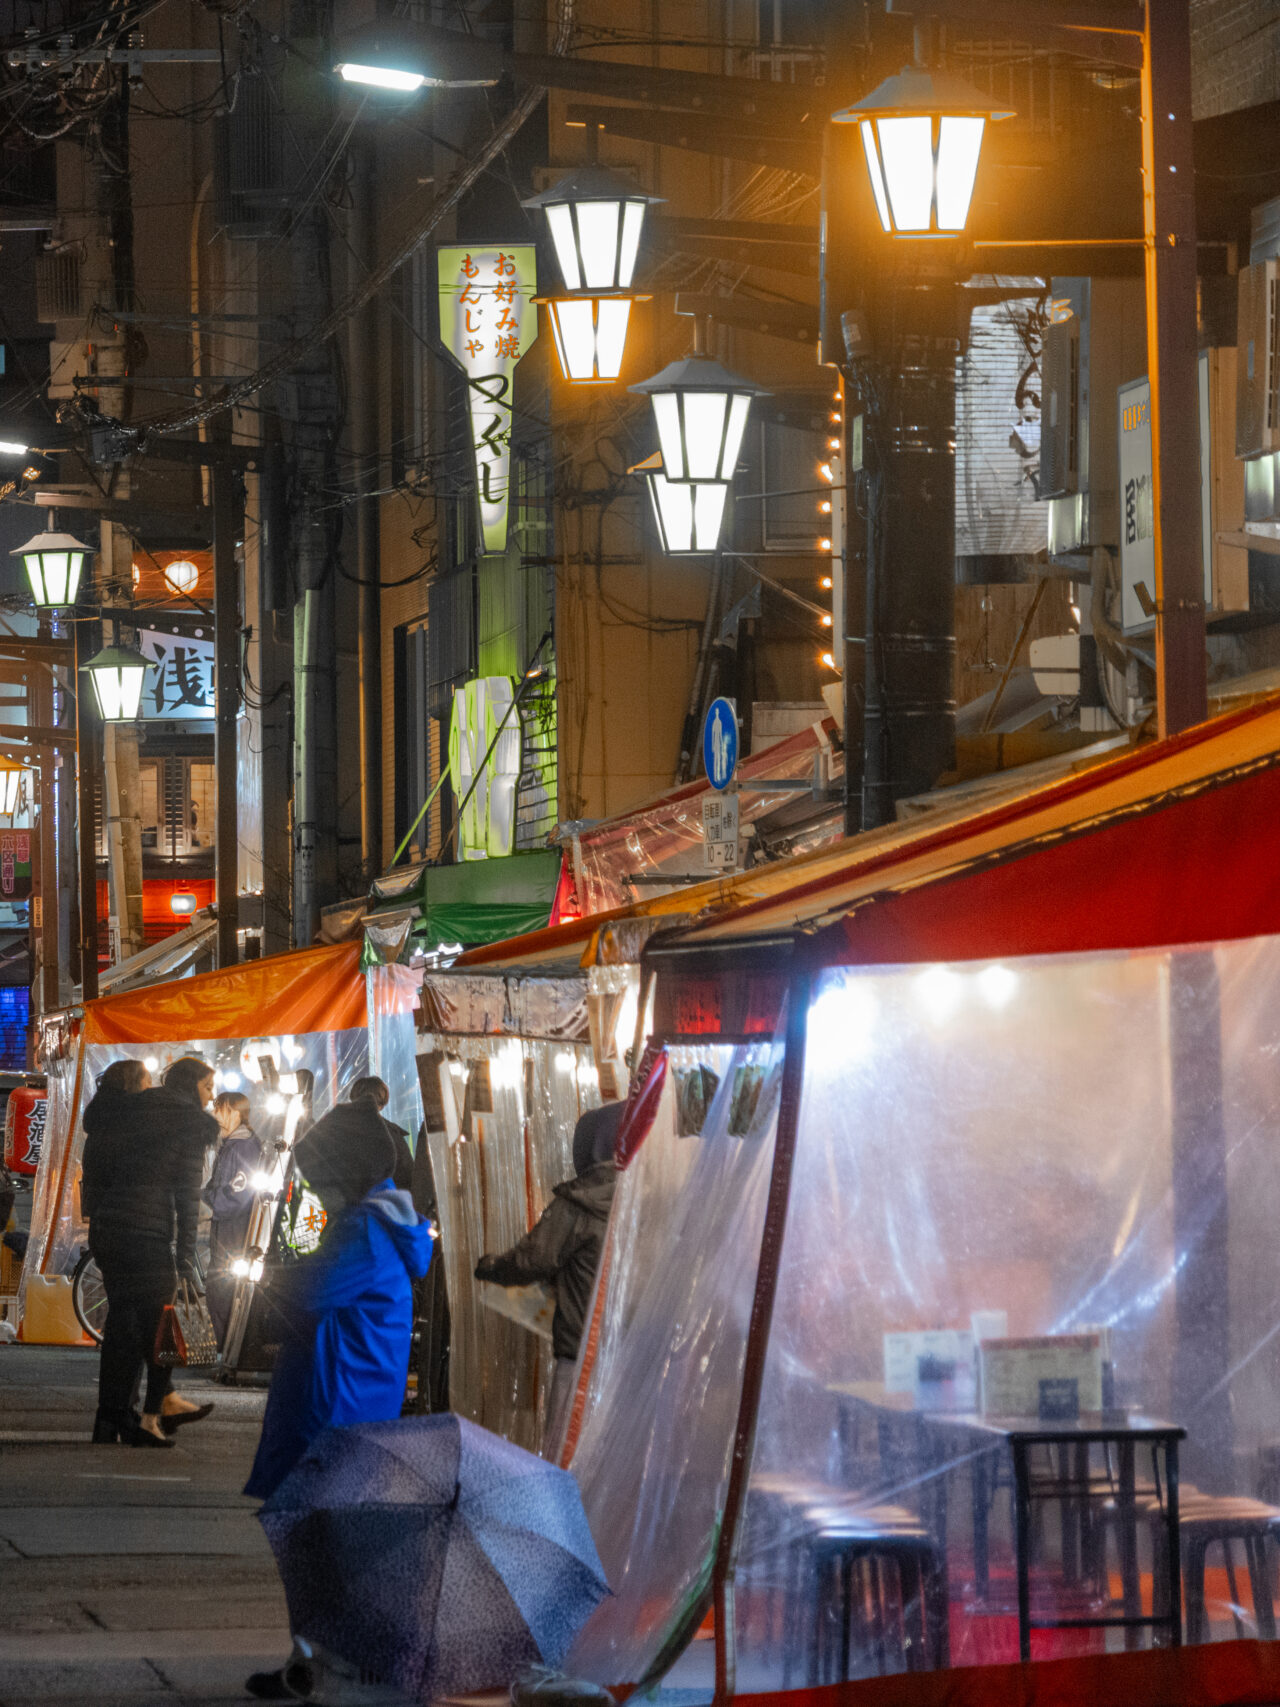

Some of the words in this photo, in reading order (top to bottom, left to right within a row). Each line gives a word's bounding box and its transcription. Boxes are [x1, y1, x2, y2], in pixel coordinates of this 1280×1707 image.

[493, 252, 521, 359] お好み焼
[468, 373, 509, 504] つくし
[150, 642, 214, 714] 浅
[1, 834, 15, 893] 六区通り
